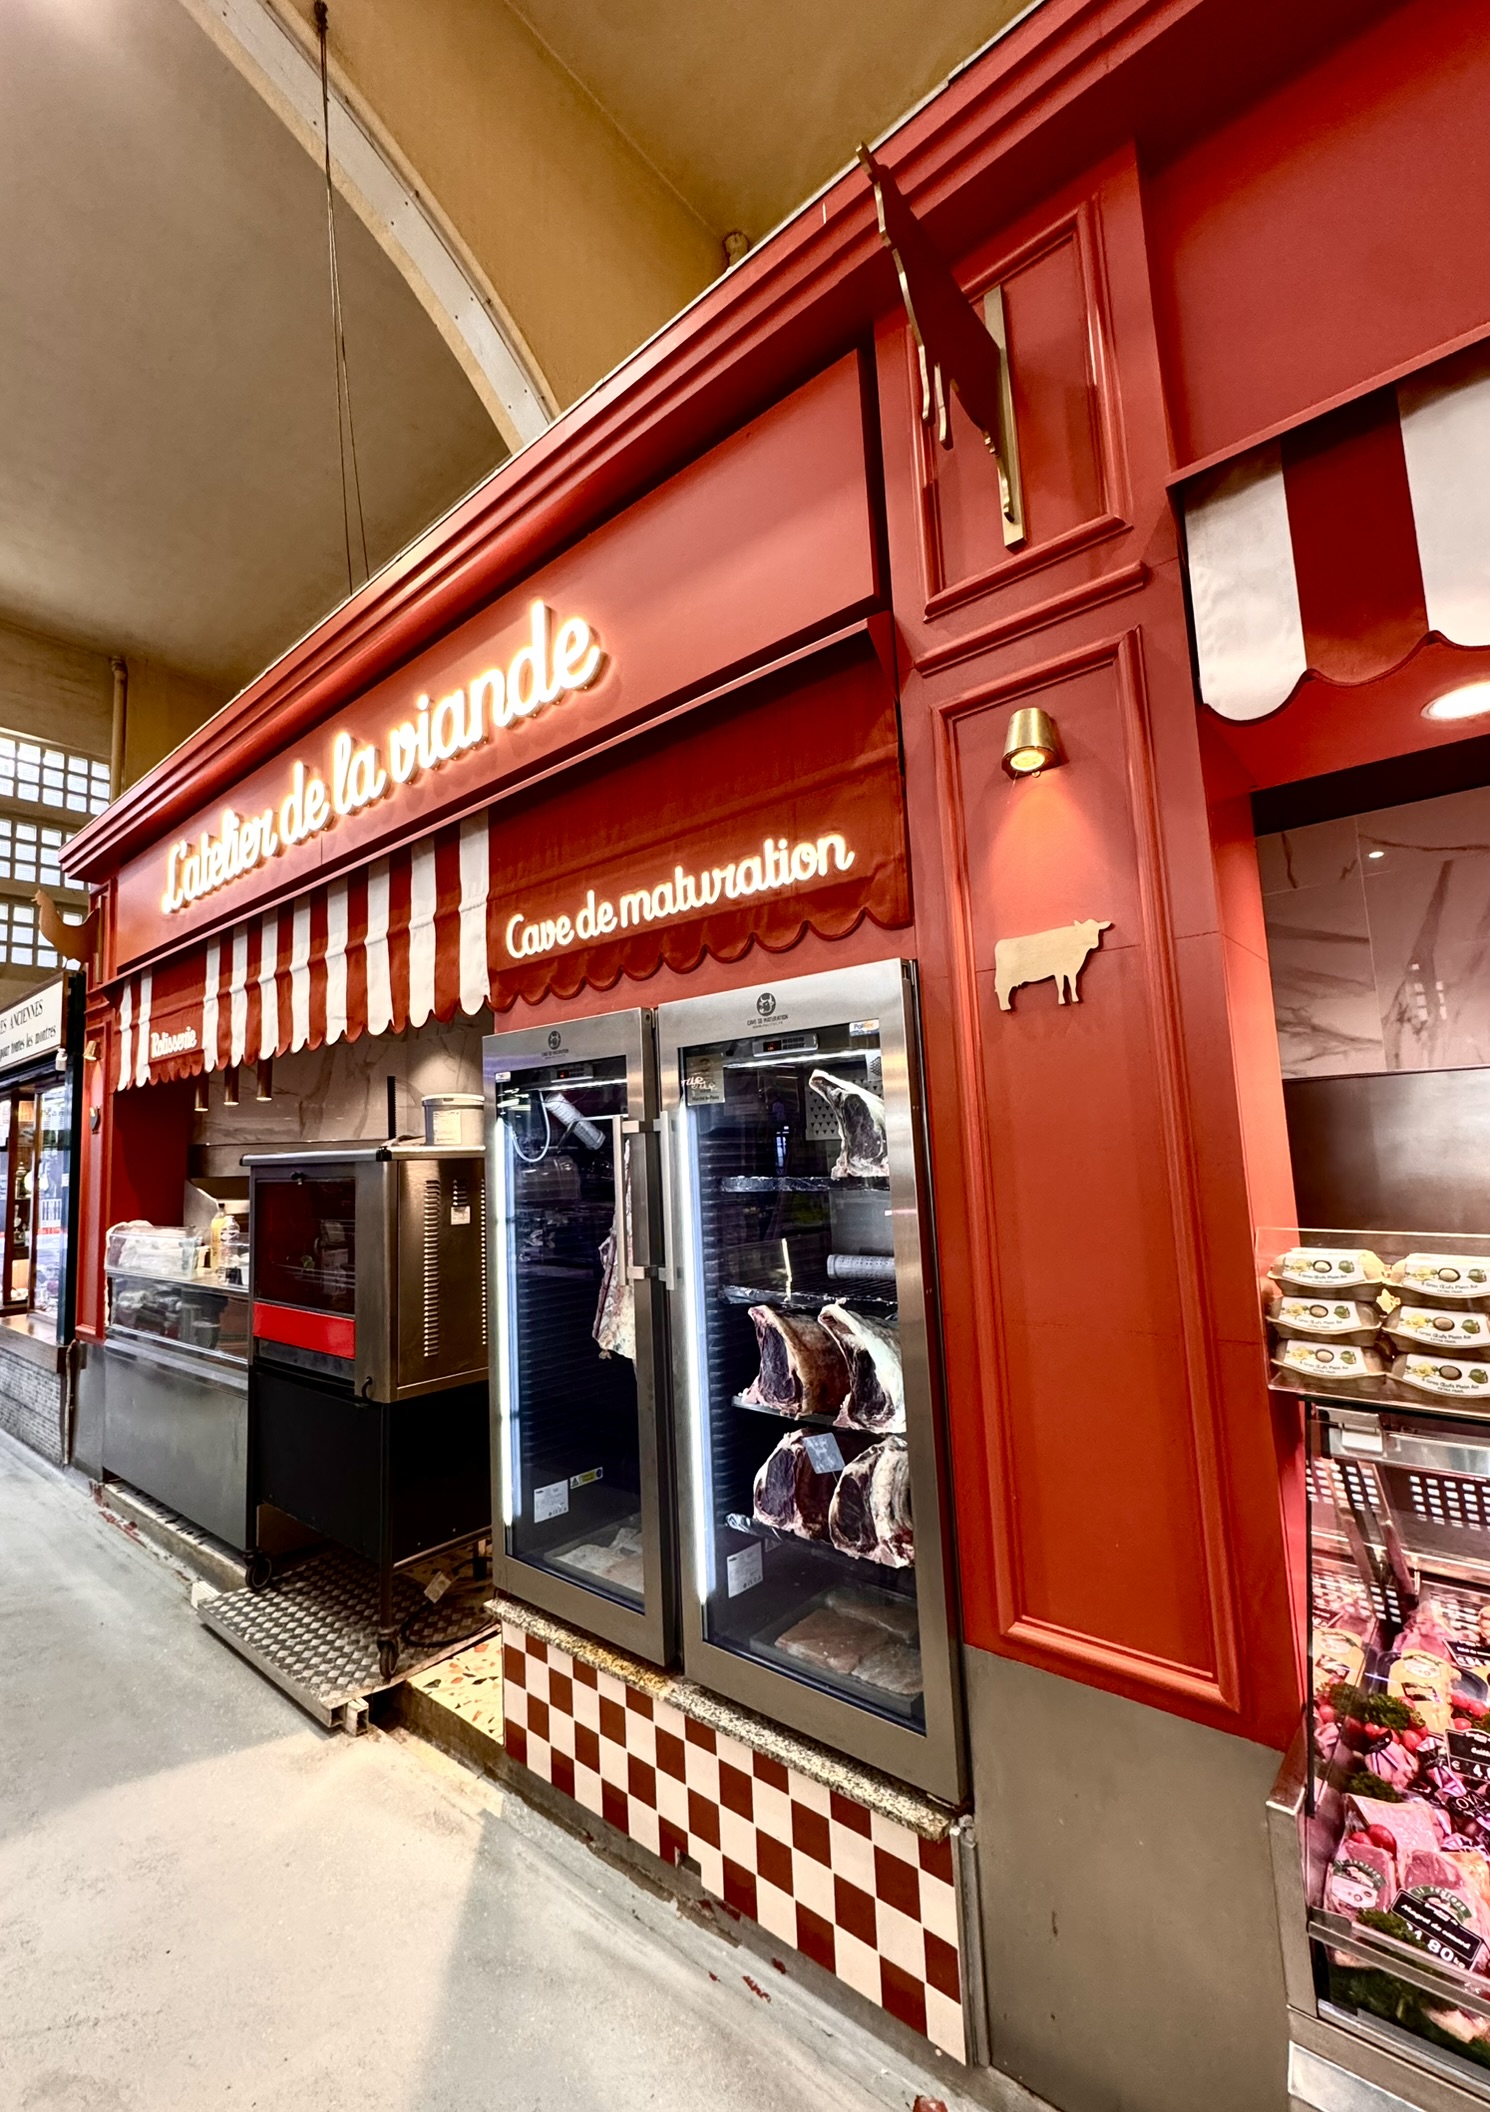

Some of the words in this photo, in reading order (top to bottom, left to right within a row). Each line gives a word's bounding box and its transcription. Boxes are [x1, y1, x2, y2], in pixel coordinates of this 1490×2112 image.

[162, 809, 277, 914] L'atelier
[280, 761, 330, 844] de
[331, 731, 387, 816] la
[388, 598, 603, 784] viande
[504, 912, 575, 960] Cave
[575, 889, 618, 941] de
[619, 832, 856, 929] maturation
[1427, 1938, 1454, 1962] 80
